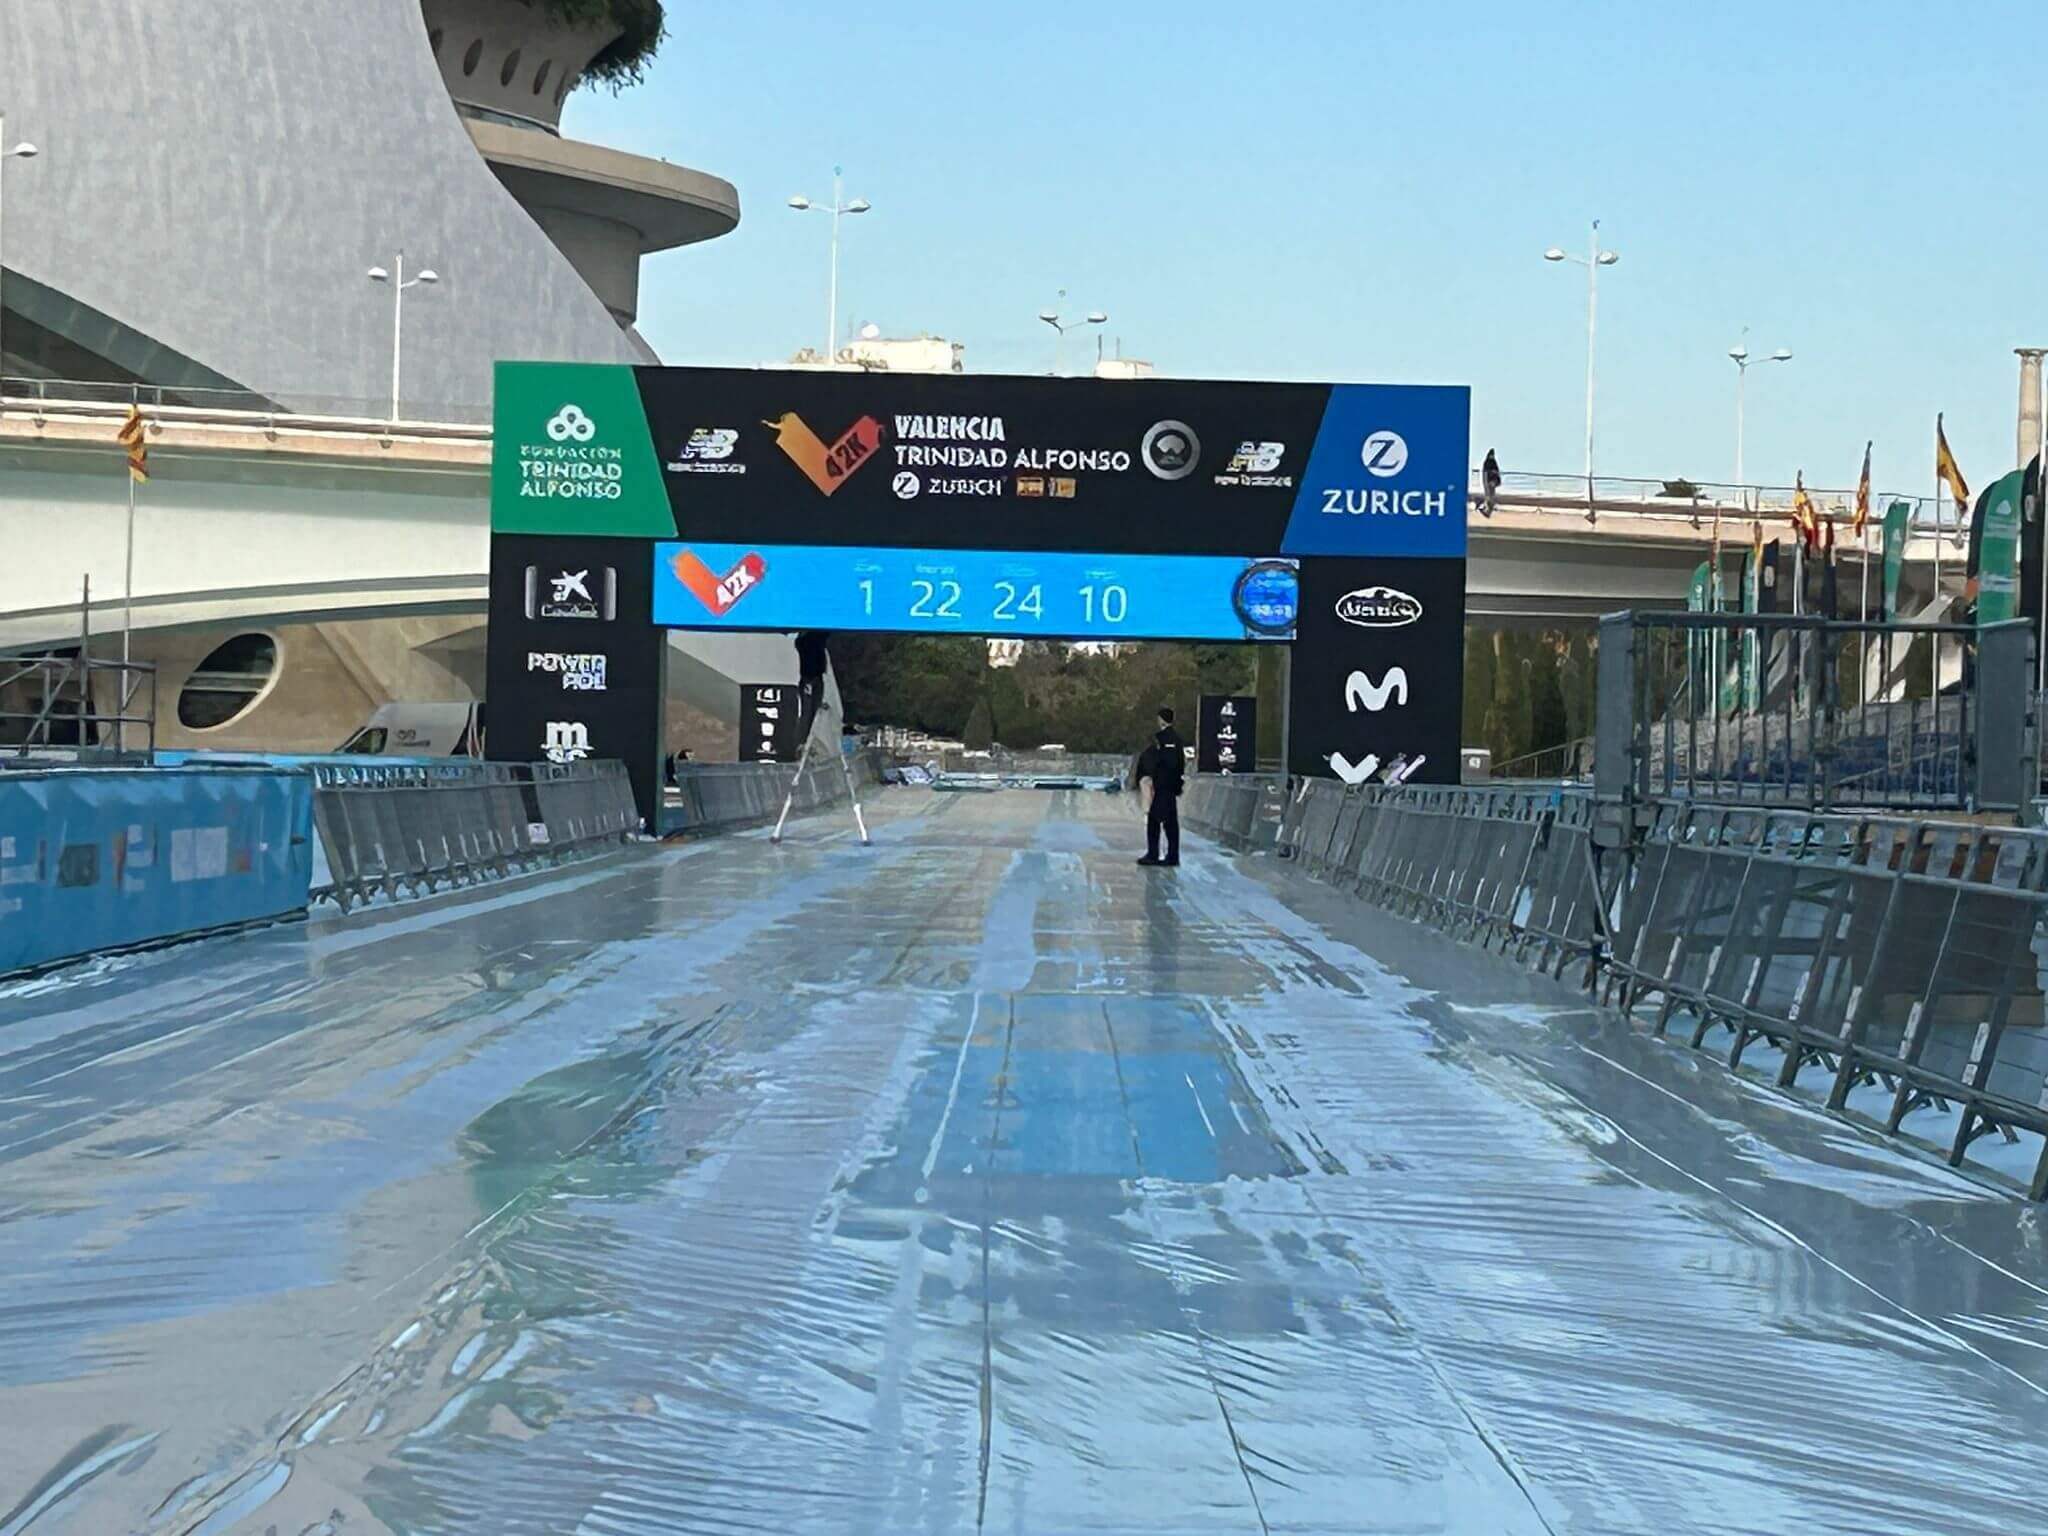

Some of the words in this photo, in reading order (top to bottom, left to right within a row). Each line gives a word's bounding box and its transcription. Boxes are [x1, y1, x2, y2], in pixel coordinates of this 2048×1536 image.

[894, 415, 1006, 441] VALENCIA
[519, 460, 622, 480] TRINIDAD
[894, 445, 1008, 468] TRINIDAD
[1014, 448, 1131, 471] ALFONSO
[520, 480, 622, 499] ALFONSO
[928, 477, 1001, 496] ZURICH
[1321, 489, 1446, 516] ZURICH
[858, 579, 873, 617] 1
[909, 580, 962, 618] 22
[992, 581, 1044, 622] 24
[1077, 584, 1128, 623] 10
